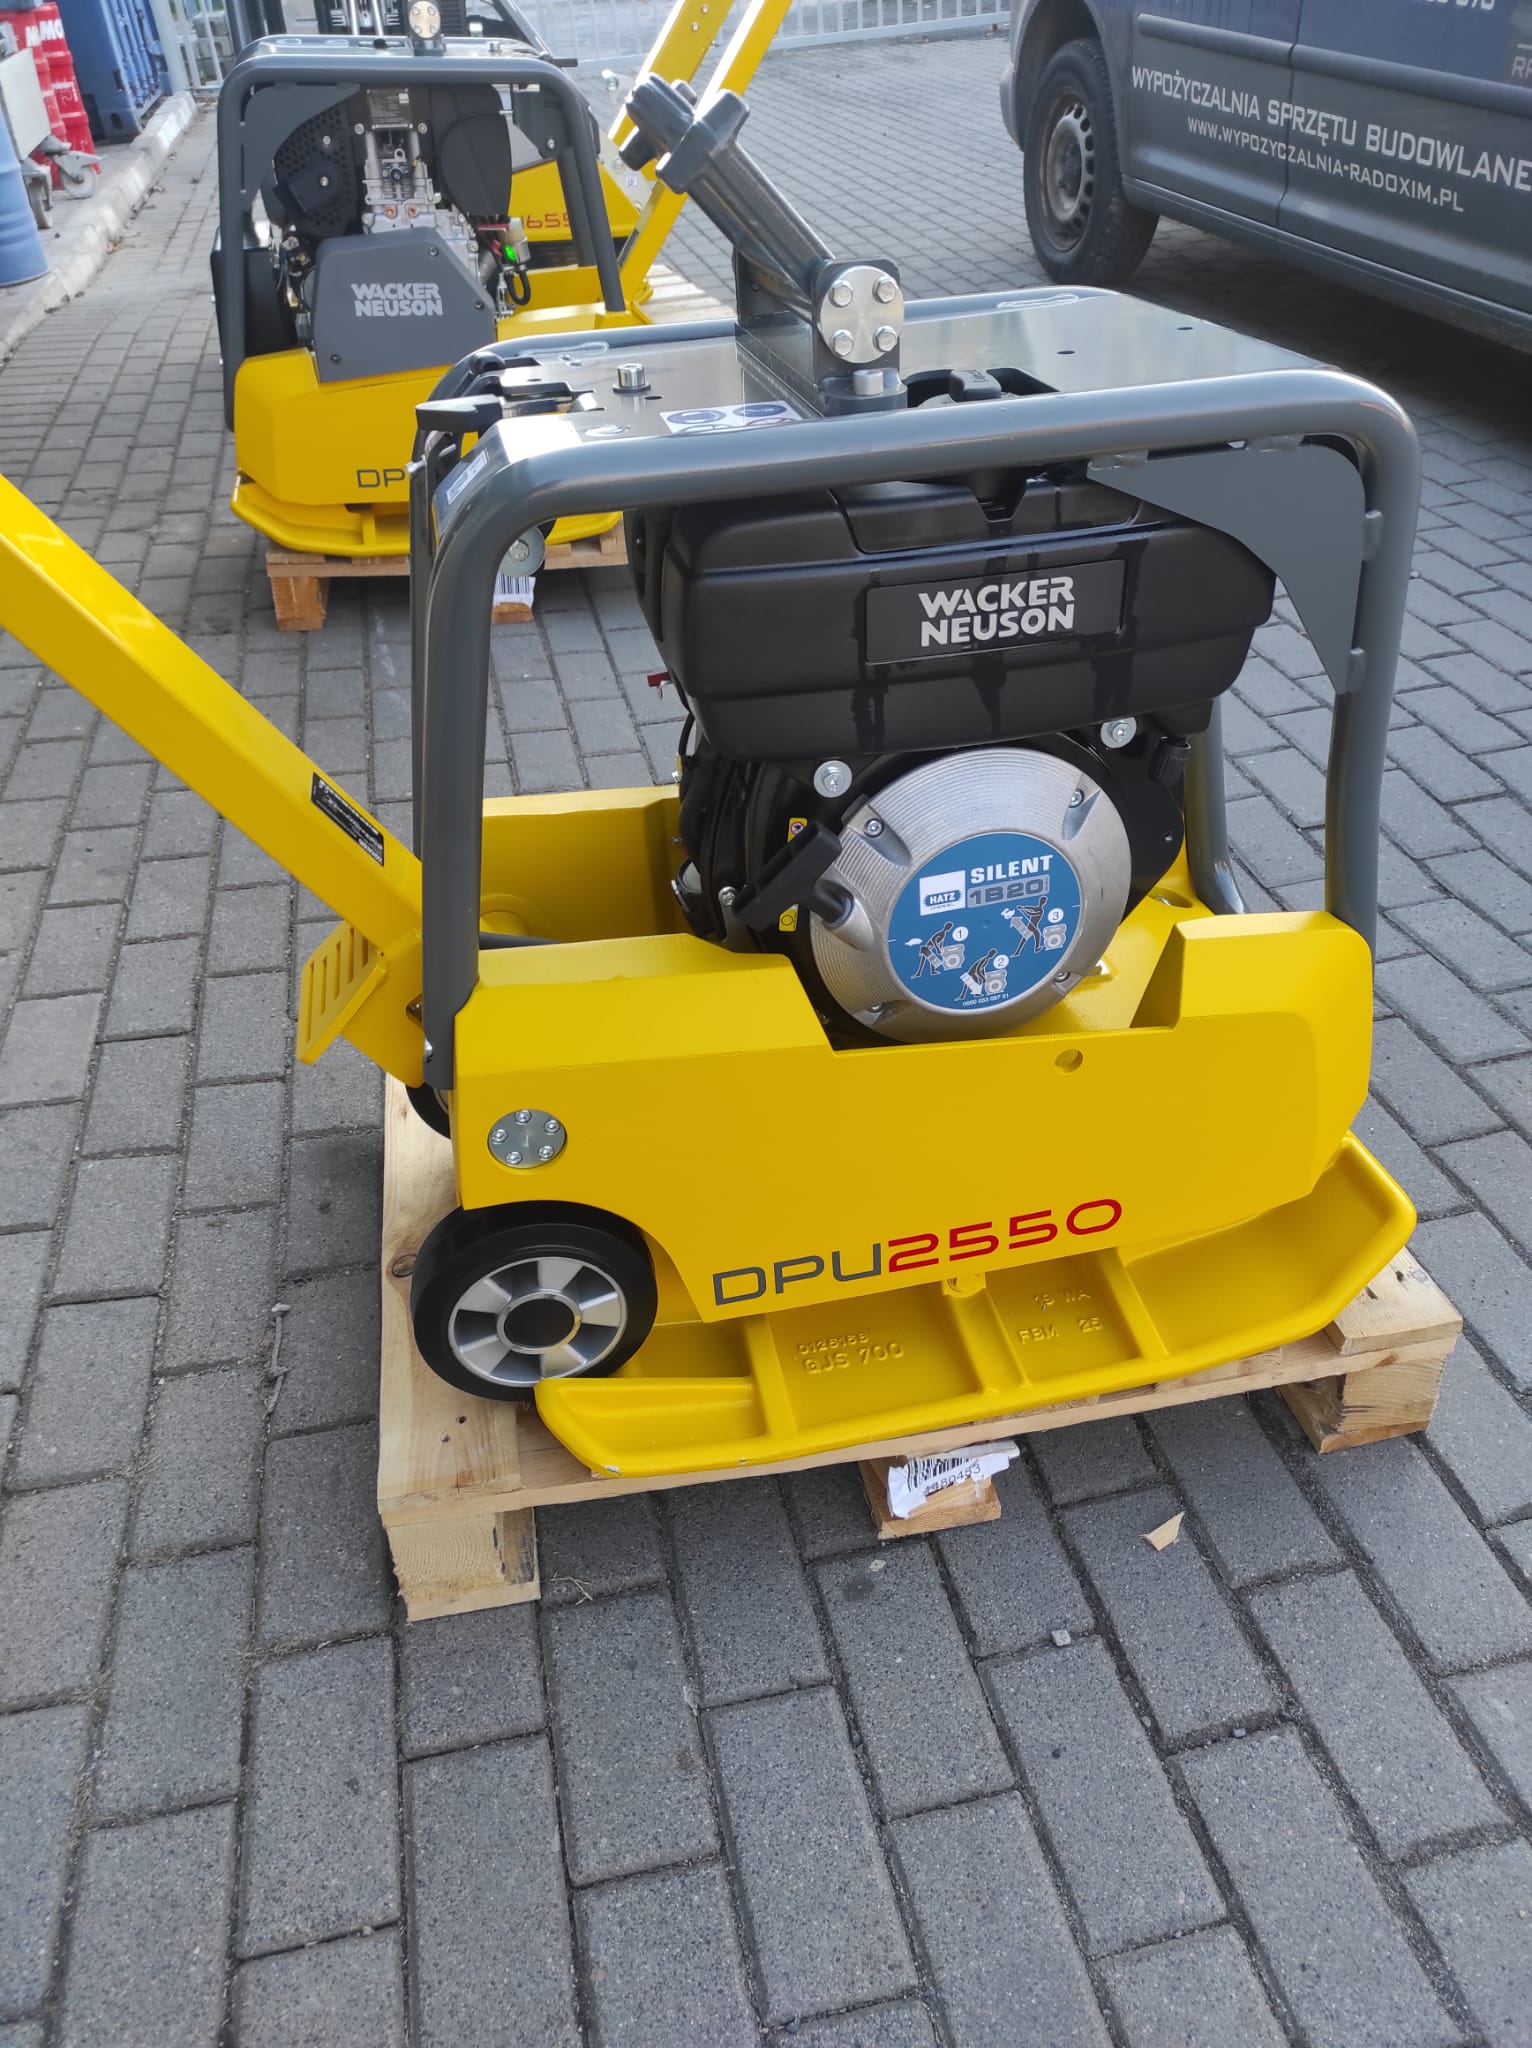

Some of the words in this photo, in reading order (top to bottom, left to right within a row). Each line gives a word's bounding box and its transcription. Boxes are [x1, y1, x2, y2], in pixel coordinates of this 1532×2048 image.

[1132, 65, 1260, 120] WYPOŻYCZALNIA
[1267, 99, 1357, 147] SPRZĘTU
[1365, 123, 1532, 192] BUDOWLANE
[1187, 116, 1464, 213] WWW.WYPOZYCZALNIA-RADOXIM.PL
[351, 282, 441, 300] WACKER
[355, 299, 443, 317] NEUSON
[918, 576, 1075, 618] WACKER
[921, 604, 1075, 647] NEUSON
[970, 854, 1053, 884] SILENT
[929, 892, 956, 905] HATZ
[969, 879, 1044, 905] 1B20
[712, 1198, 1122, 1306] DPU2550
[1078, 1315, 1103, 1333] 25
[858, 1342, 905, 1365] 700
